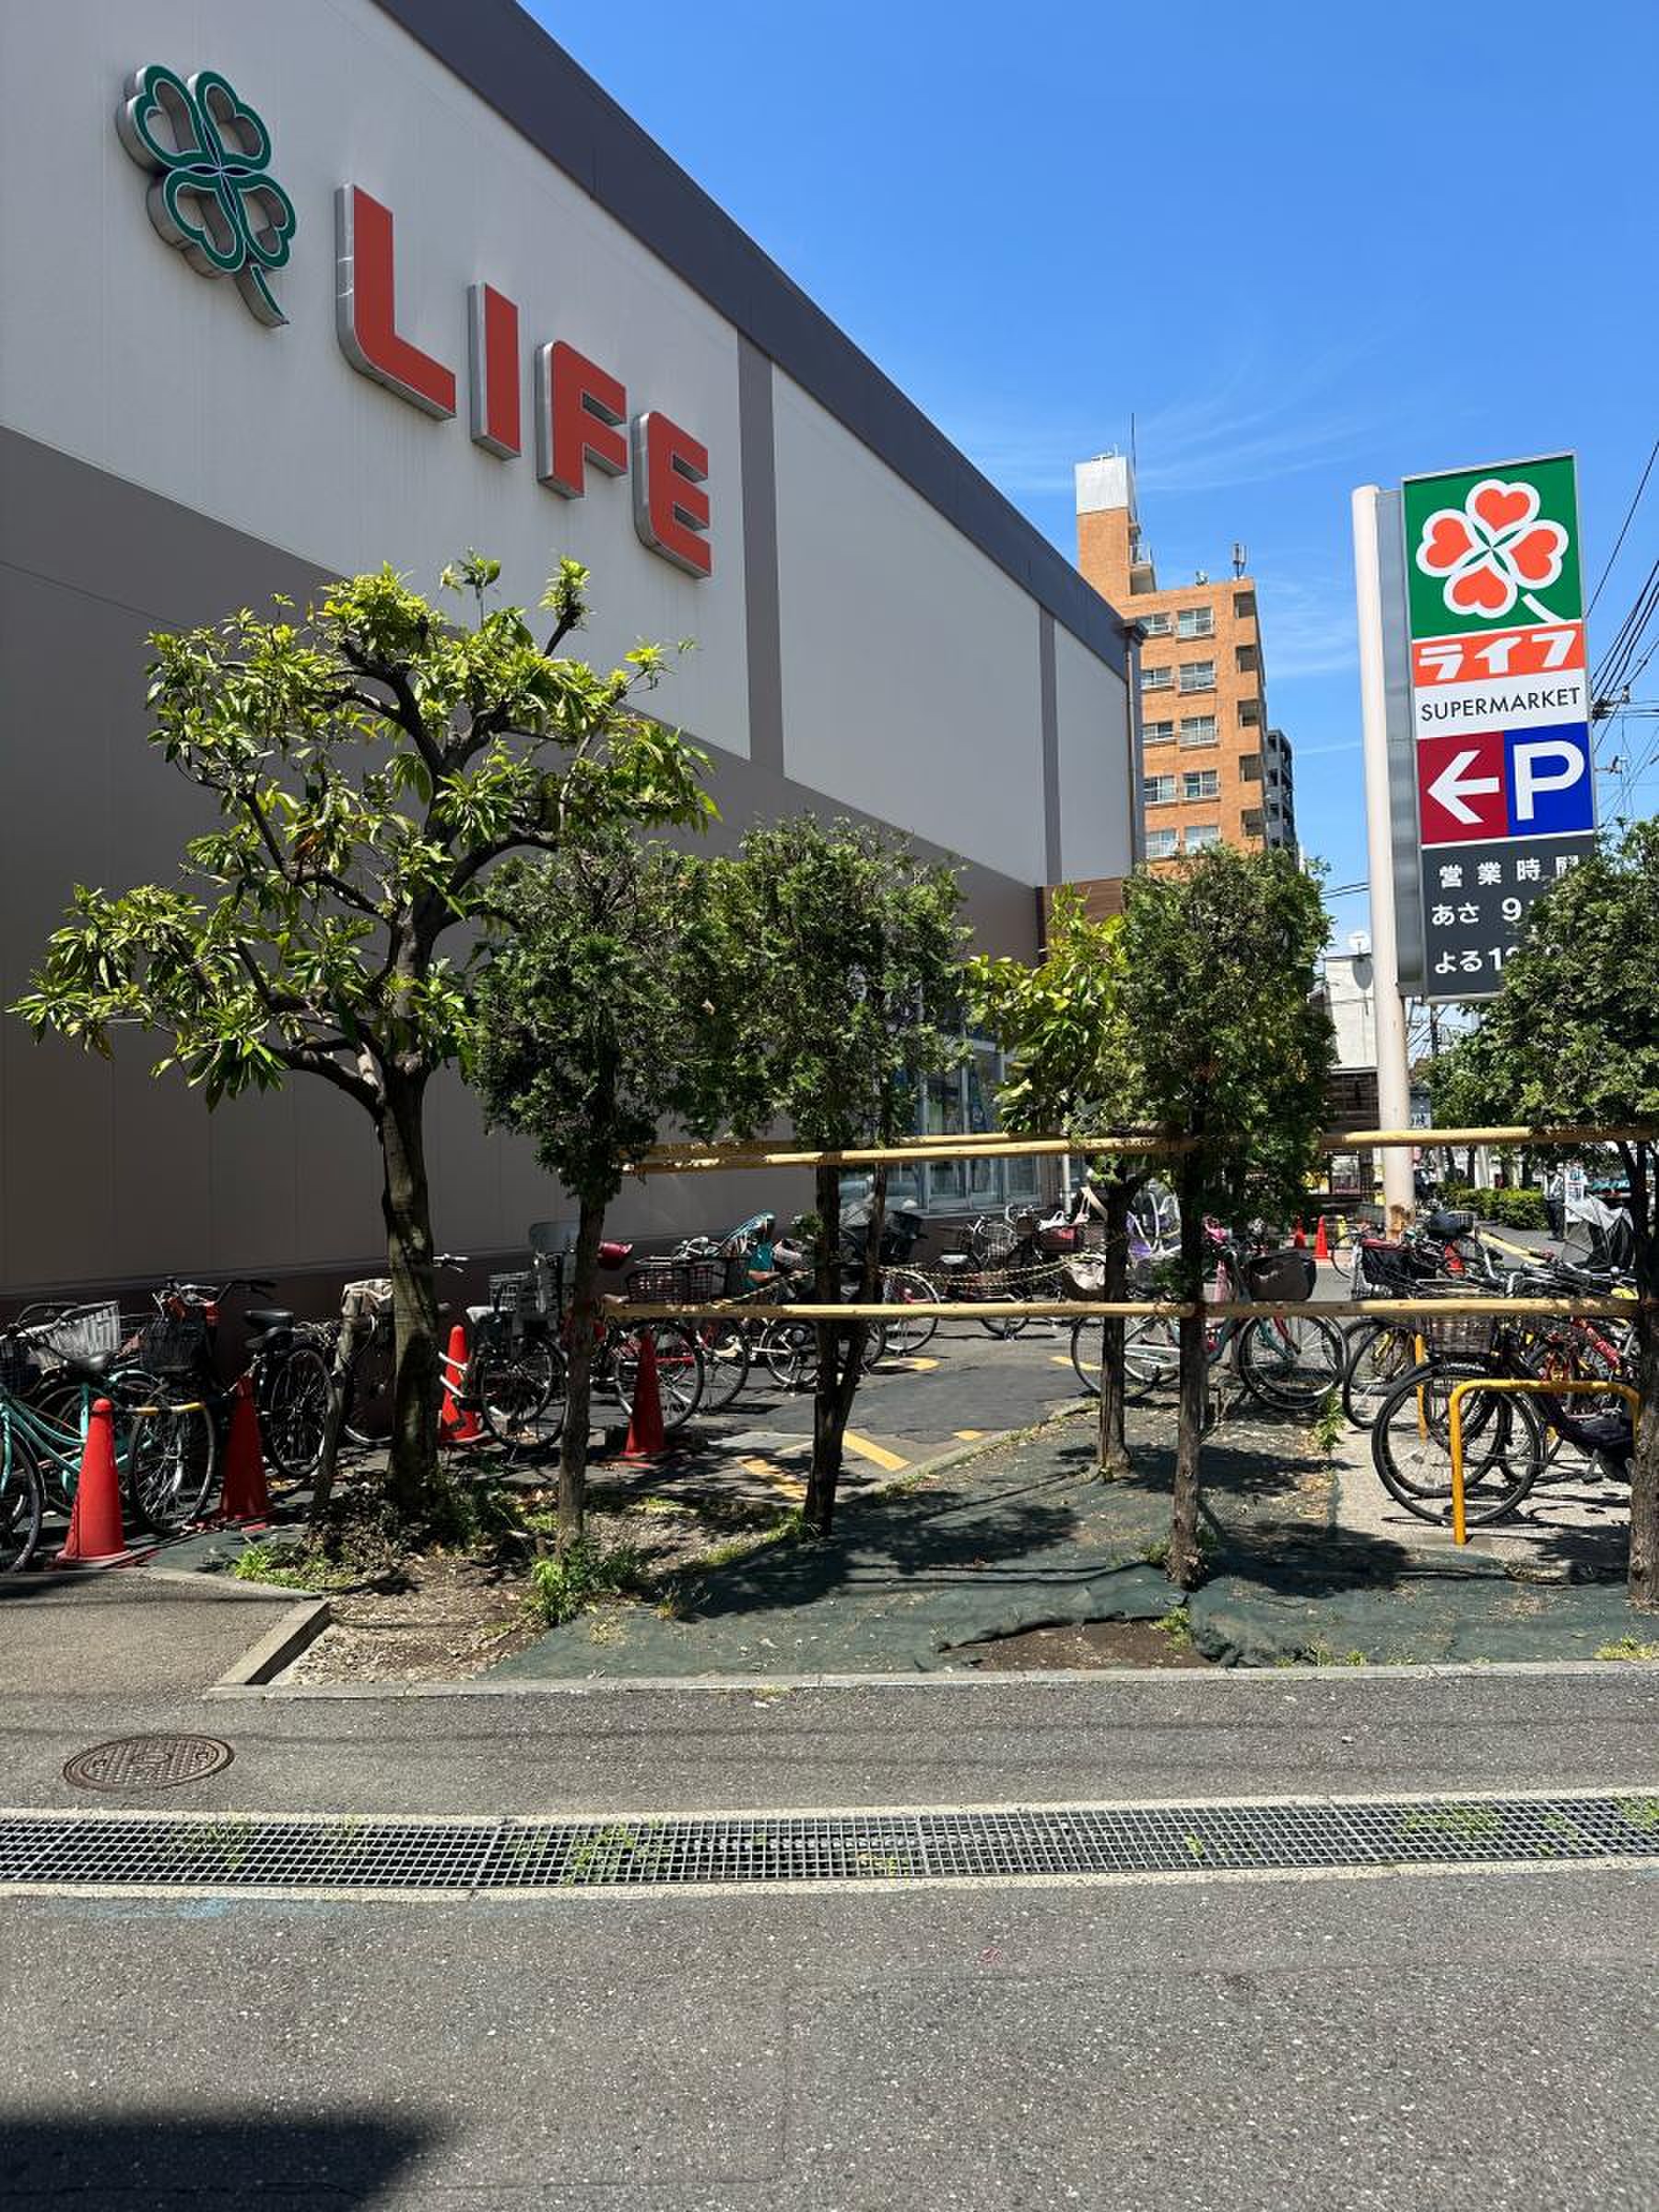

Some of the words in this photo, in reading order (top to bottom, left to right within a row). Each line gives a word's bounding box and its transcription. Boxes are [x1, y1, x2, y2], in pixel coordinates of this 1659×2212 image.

[335, 184, 712, 579] LIFE
[1418, 630, 1576, 680] ライフ
[1421, 687, 1581, 722] SUPERMARKET
[1513, 740, 1585, 821] P
[1431, 902, 1480, 926] あさ
